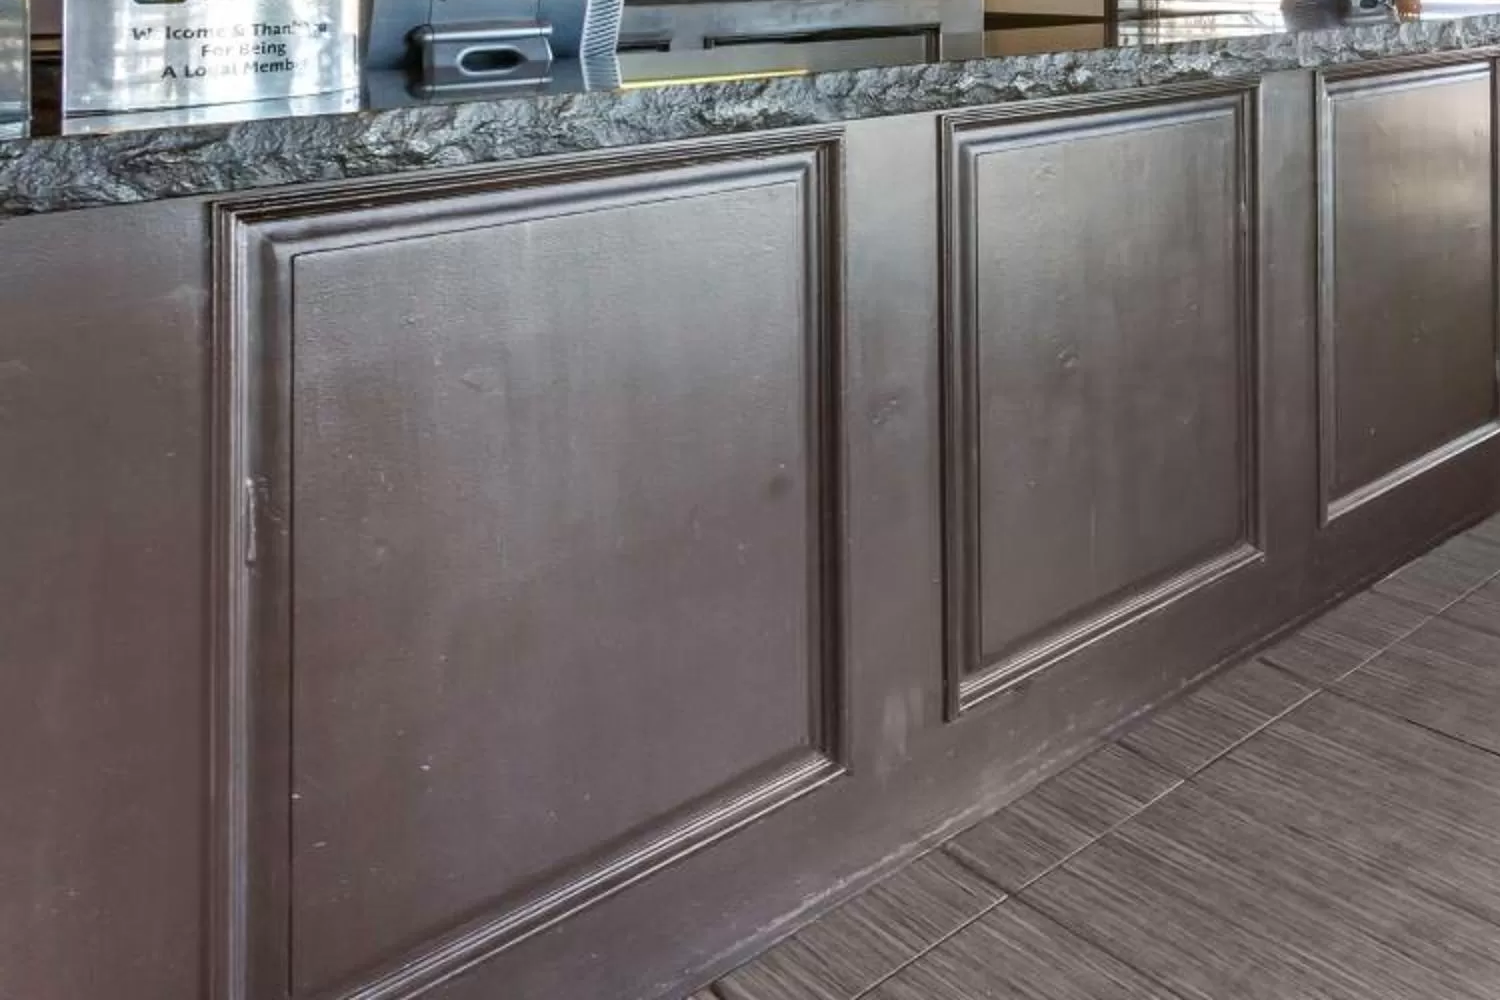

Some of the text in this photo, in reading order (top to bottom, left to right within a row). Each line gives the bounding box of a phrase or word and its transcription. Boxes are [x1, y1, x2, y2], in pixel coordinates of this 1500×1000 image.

[132, 23, 225, 41] Wlcome
[239, 41, 287, 57] Being
[161, 65, 177, 79] A
[184, 61, 238, 79] Loal
